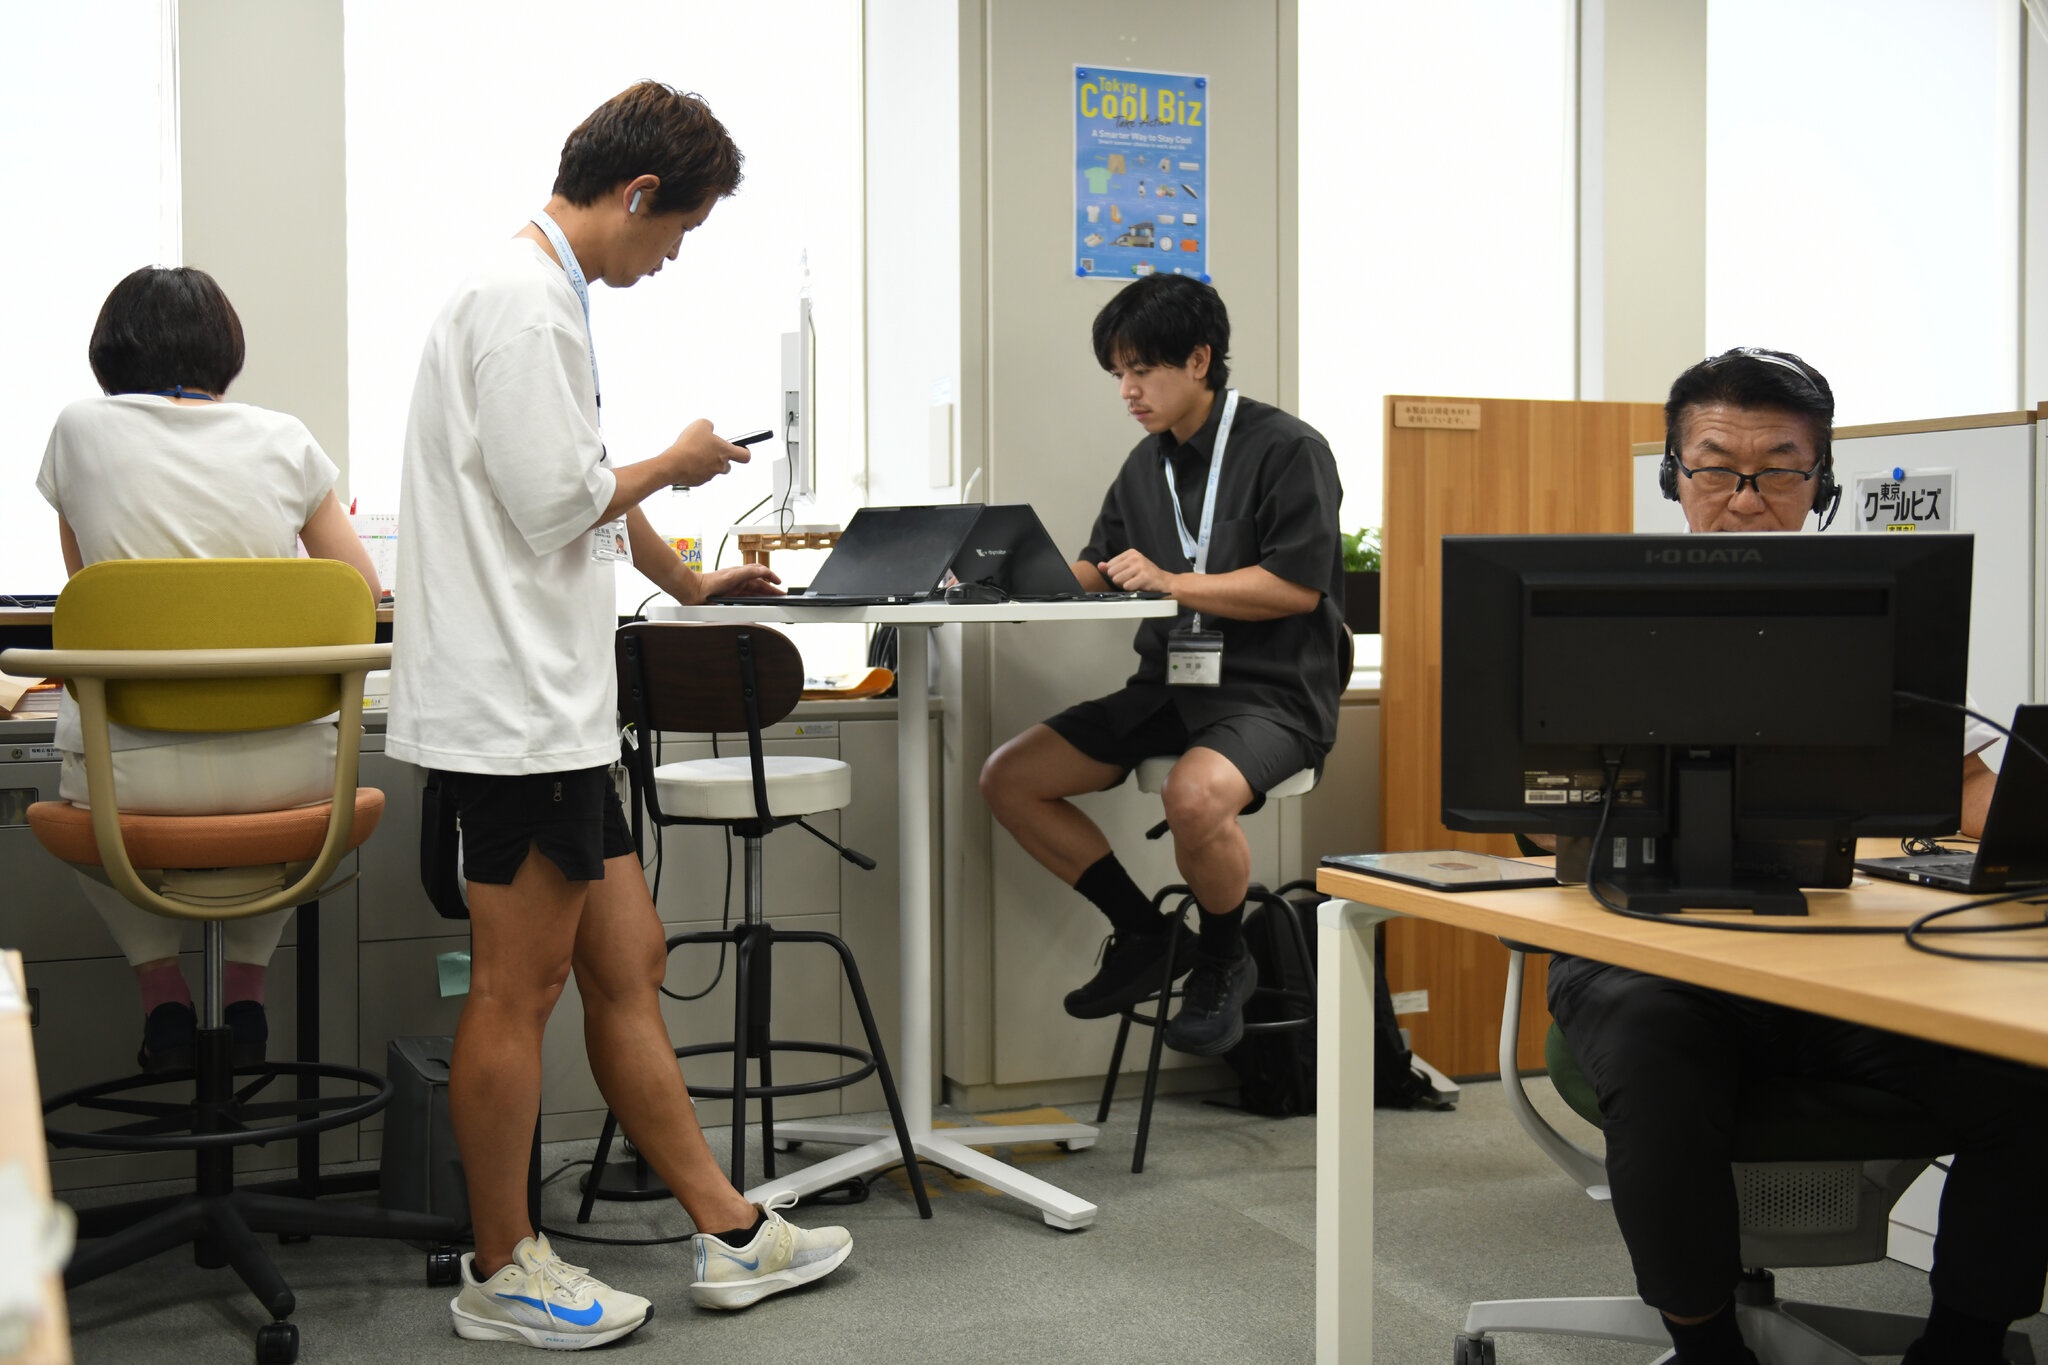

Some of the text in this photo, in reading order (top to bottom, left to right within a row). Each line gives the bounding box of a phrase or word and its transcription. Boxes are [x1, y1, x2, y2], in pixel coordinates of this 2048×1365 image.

[1098, 76, 1137, 97] Tokyo
[1080, 83, 1203, 127] Cool Biz
[1112, 113, 1135, 129] Take
[1092, 129, 1192, 144] A Smarter Way to Stay Cool
[1880, 482, 1900, 501] 東京
[1865, 487, 1942, 522] クールビズ
[1687, 548, 1762, 563] DATA
